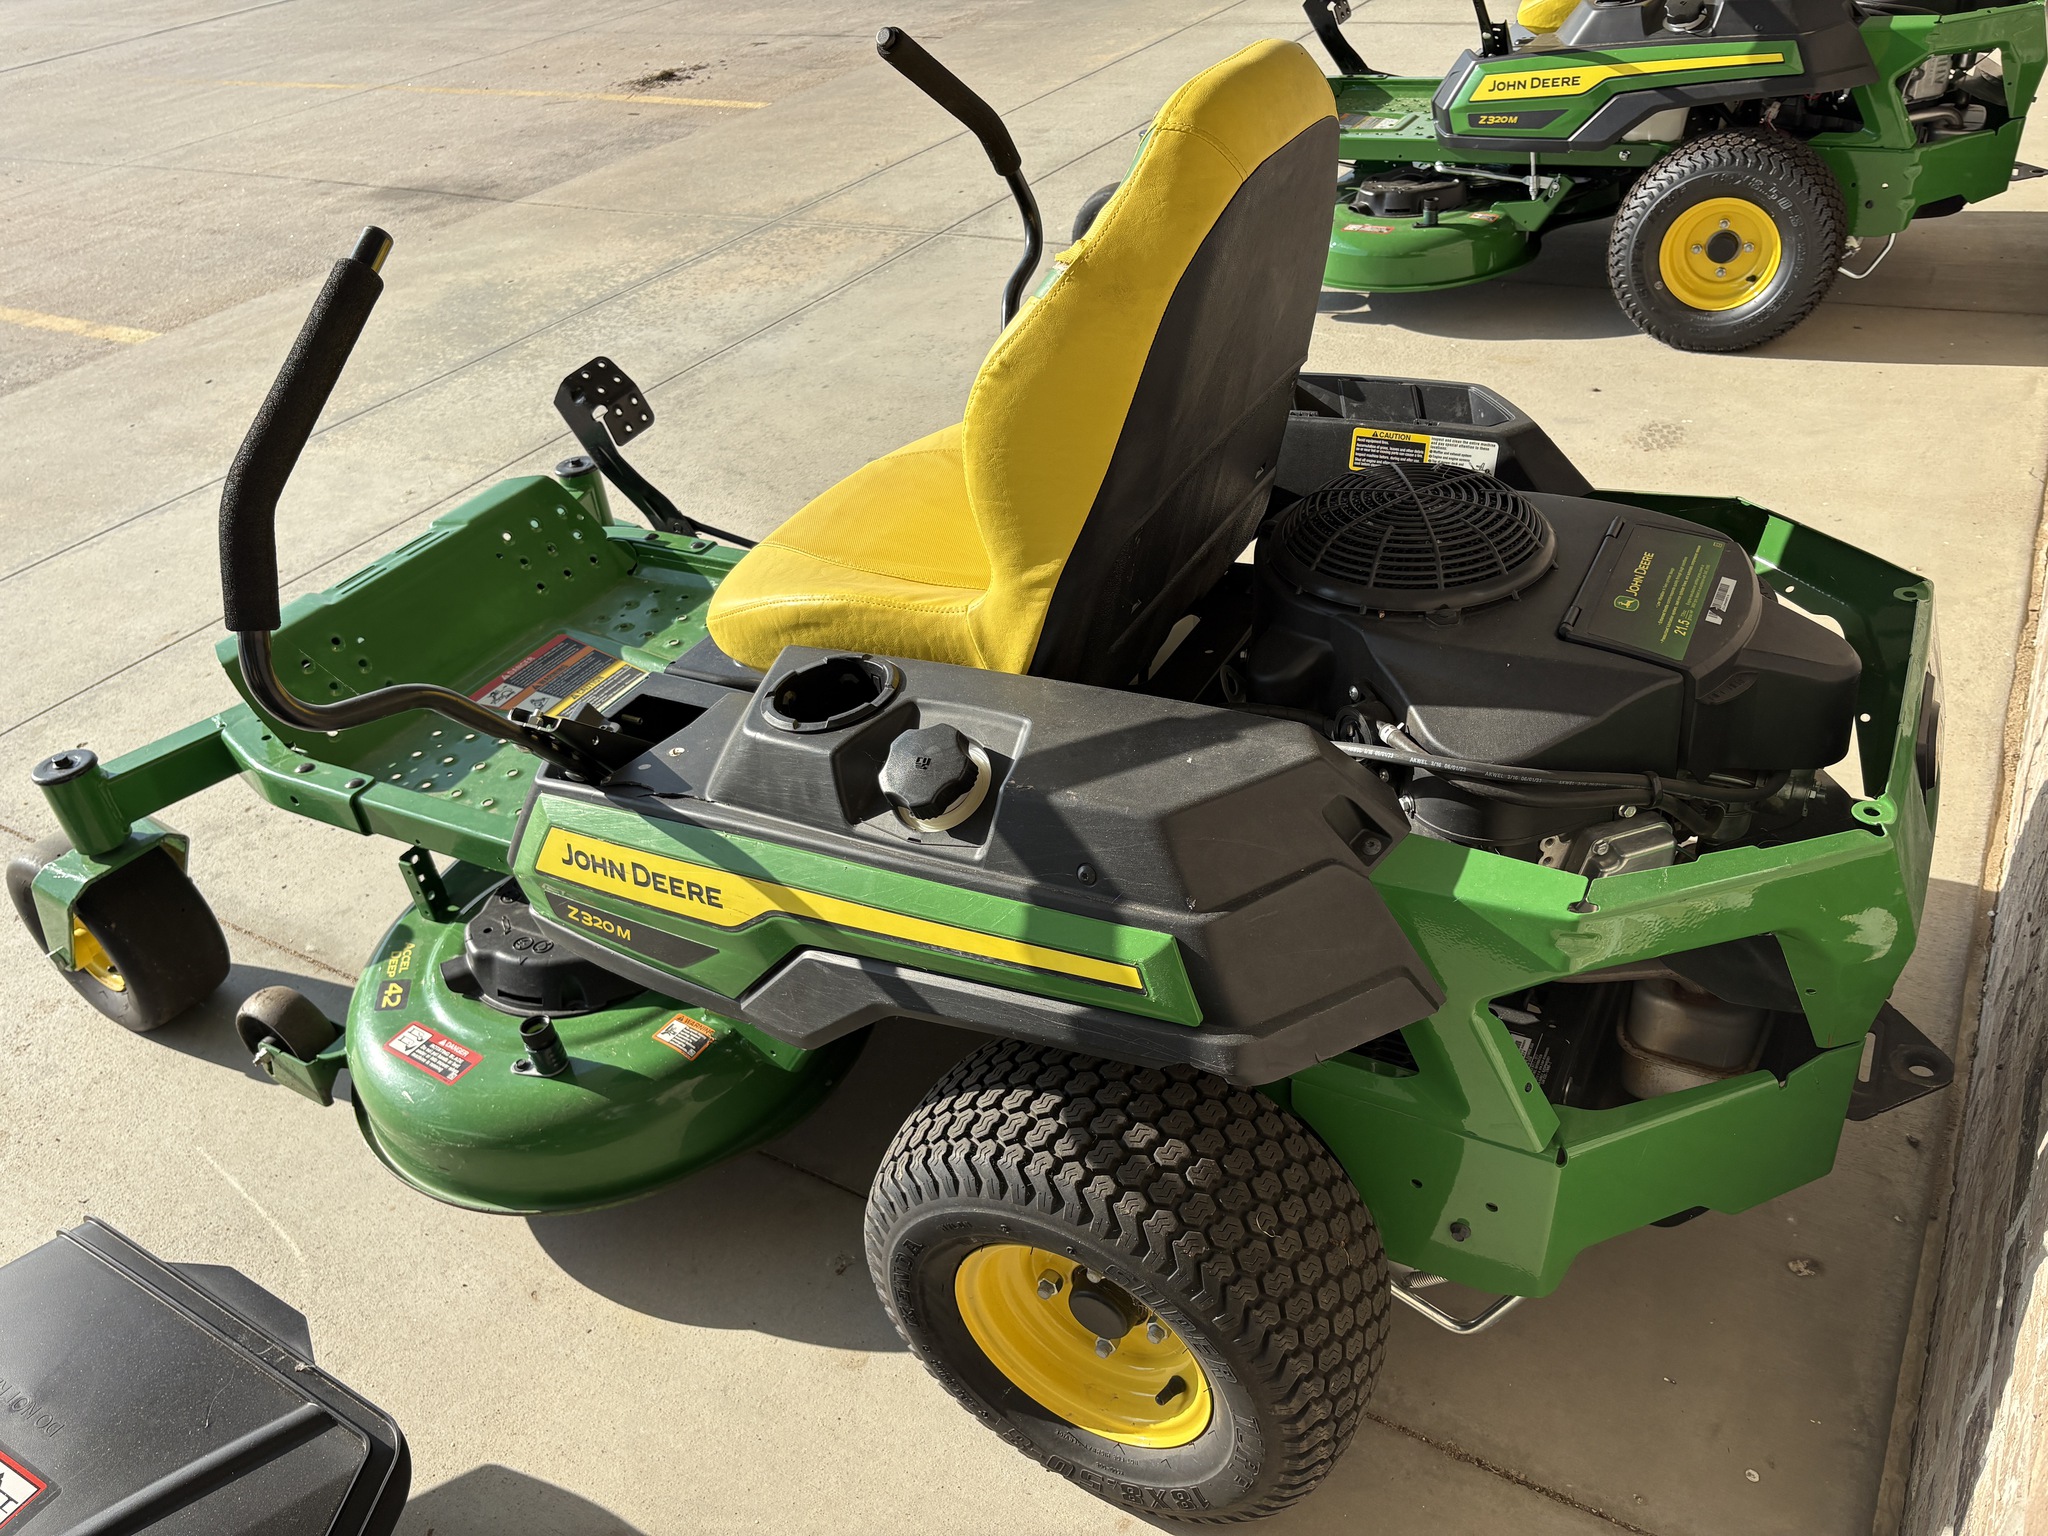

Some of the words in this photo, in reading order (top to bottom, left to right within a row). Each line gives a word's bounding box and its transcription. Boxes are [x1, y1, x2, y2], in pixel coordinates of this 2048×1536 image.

[1488, 79, 1527, 92] JOHN
[1530, 76, 1580, 89] DEERE
[1478, 115, 1518, 125] Z320M
[1379, 432, 1411, 440] CAUTION
[1634, 551, 1655, 576] DEERE
[1626, 571, 1643, 596] JOHN
[1674, 619, 1690, 636] 21.5
[562, 844, 626, 882] JOHN
[631, 862, 723, 909] DEERE
[567, 905, 631, 941] Z320M
[387, 951, 398, 978] DEEP
[399, 942, 415, 974] ACCEL
[382, 983, 403, 1008] 42
[445, 1041, 470, 1057] DANGER
[893, 1239, 926, 1327] KENDA
[1103, 1266, 1238, 1385] SUPER
[34, 1414, 66, 1438] DO
[1229, 1409, 1266, 1493] TURF
